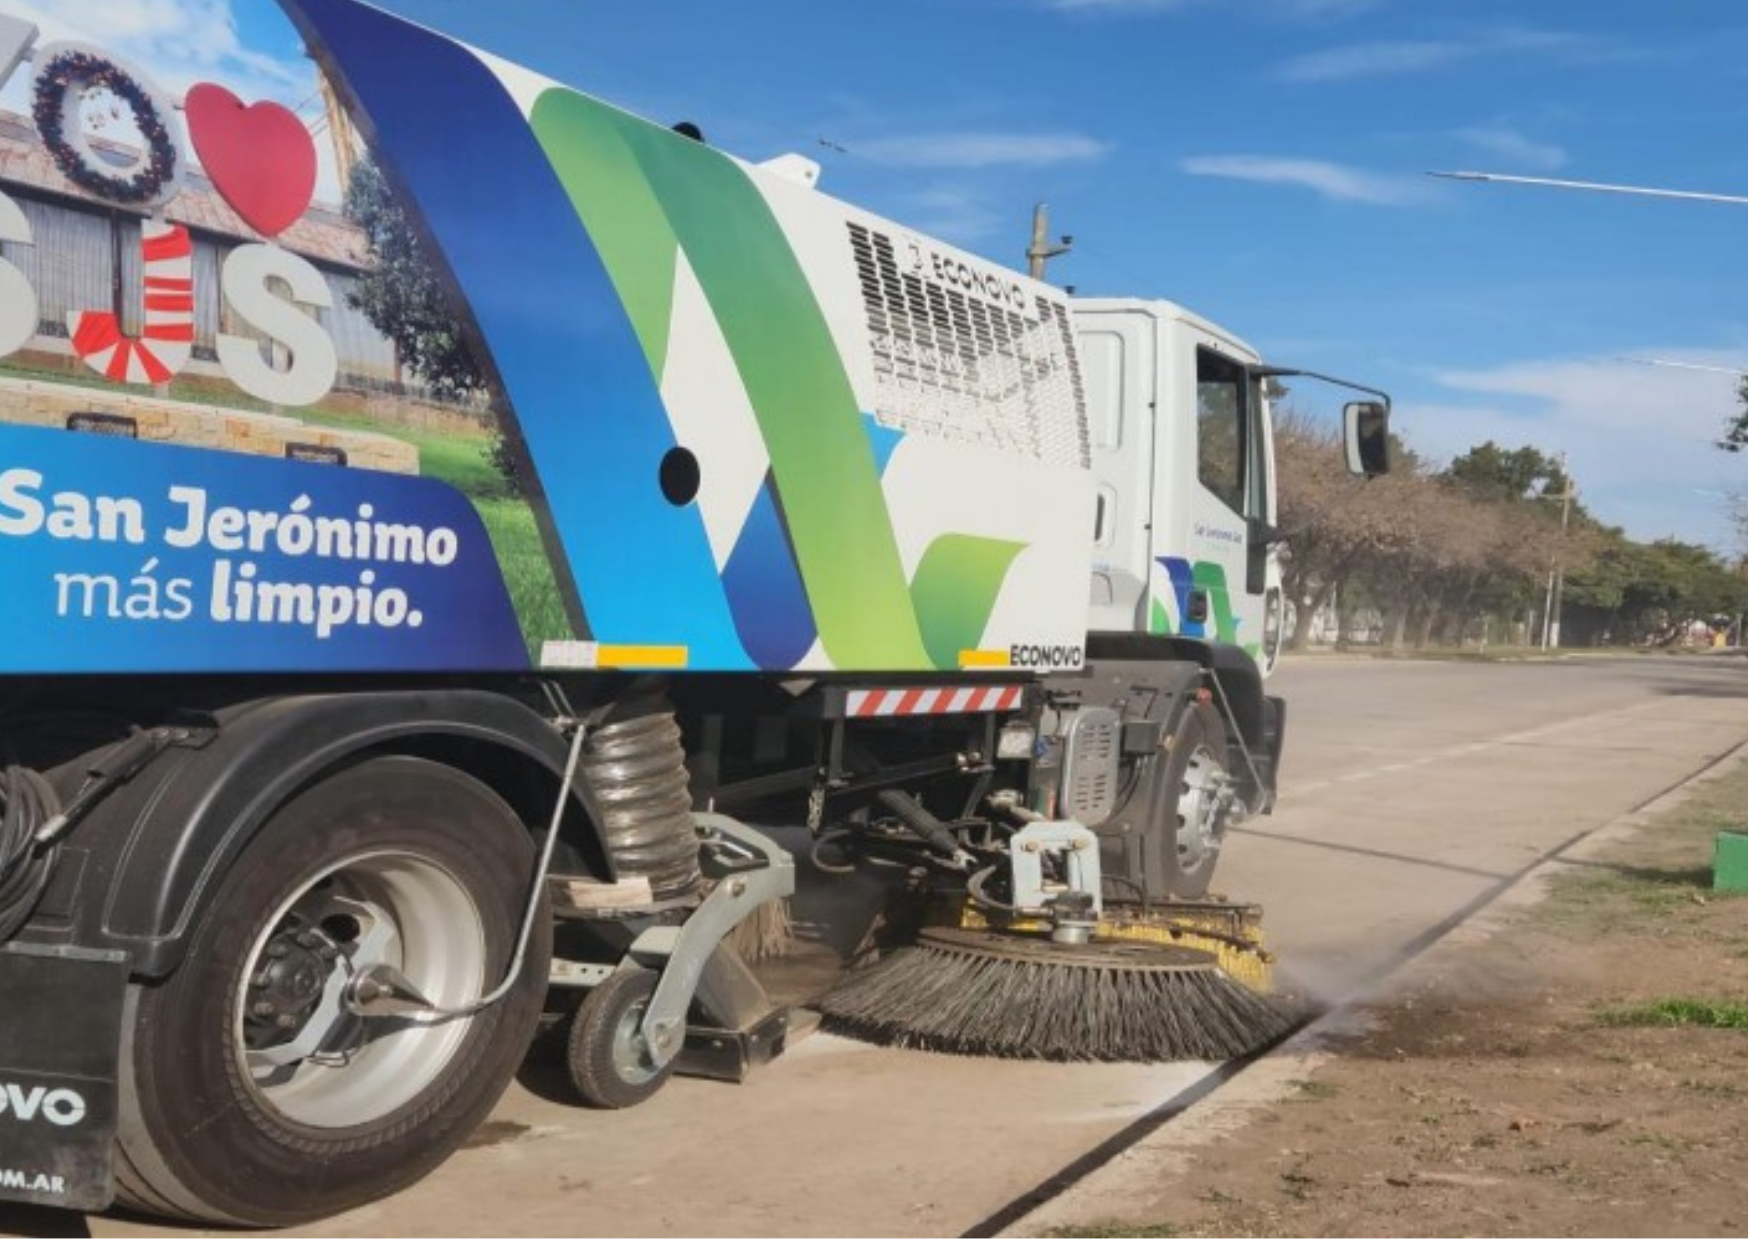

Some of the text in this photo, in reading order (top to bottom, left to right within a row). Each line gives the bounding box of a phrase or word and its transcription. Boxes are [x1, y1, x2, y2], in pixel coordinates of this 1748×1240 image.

[930, 251, 1025, 310] ECONOVO
[0, 468, 459, 566] San Jerónimo
[54, 557, 424, 639] más limpio.
[1010, 644, 1081, 666] ECONOVO
[0, 1083, 86, 1126] VO
[0, 1169, 65, 1193] M.AR
